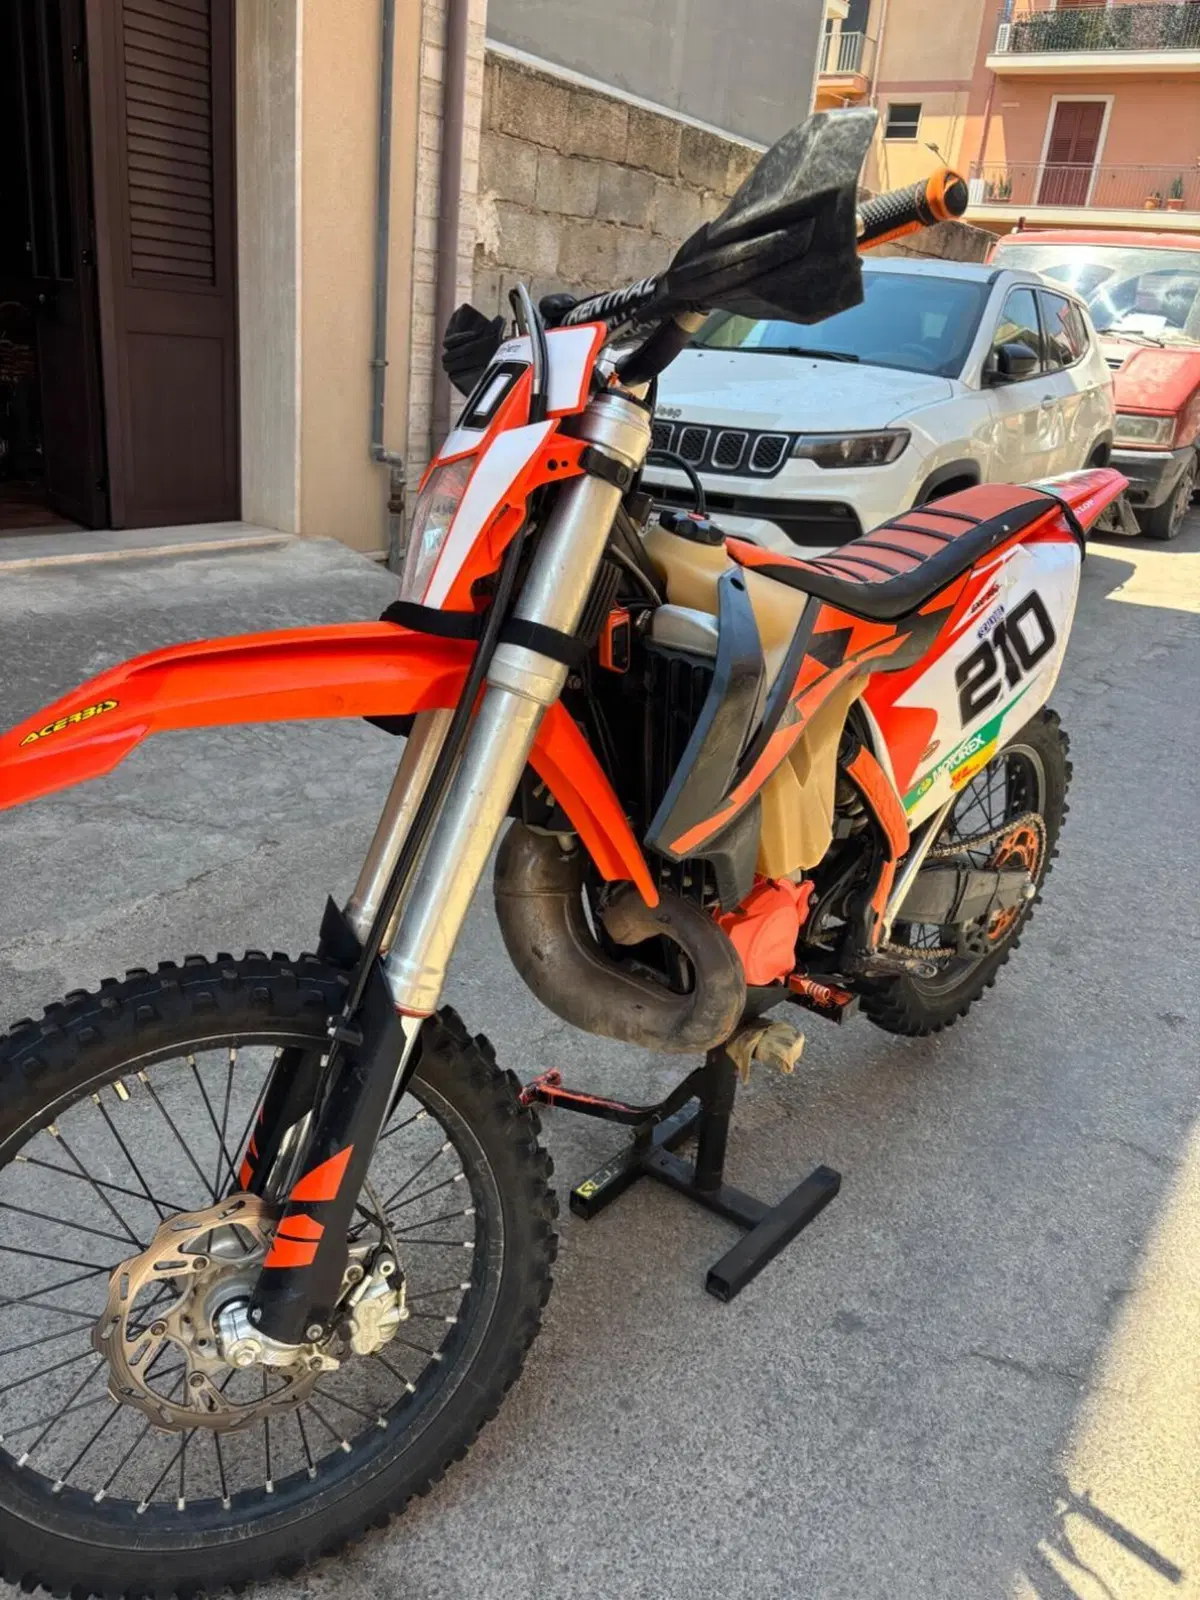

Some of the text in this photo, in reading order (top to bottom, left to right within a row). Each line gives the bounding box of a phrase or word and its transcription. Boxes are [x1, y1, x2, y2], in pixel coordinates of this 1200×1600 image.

[954, 588, 1057, 730] 210
[19, 700, 119, 747] ACERBIS
[932, 733, 986, 782] MOTOREX
